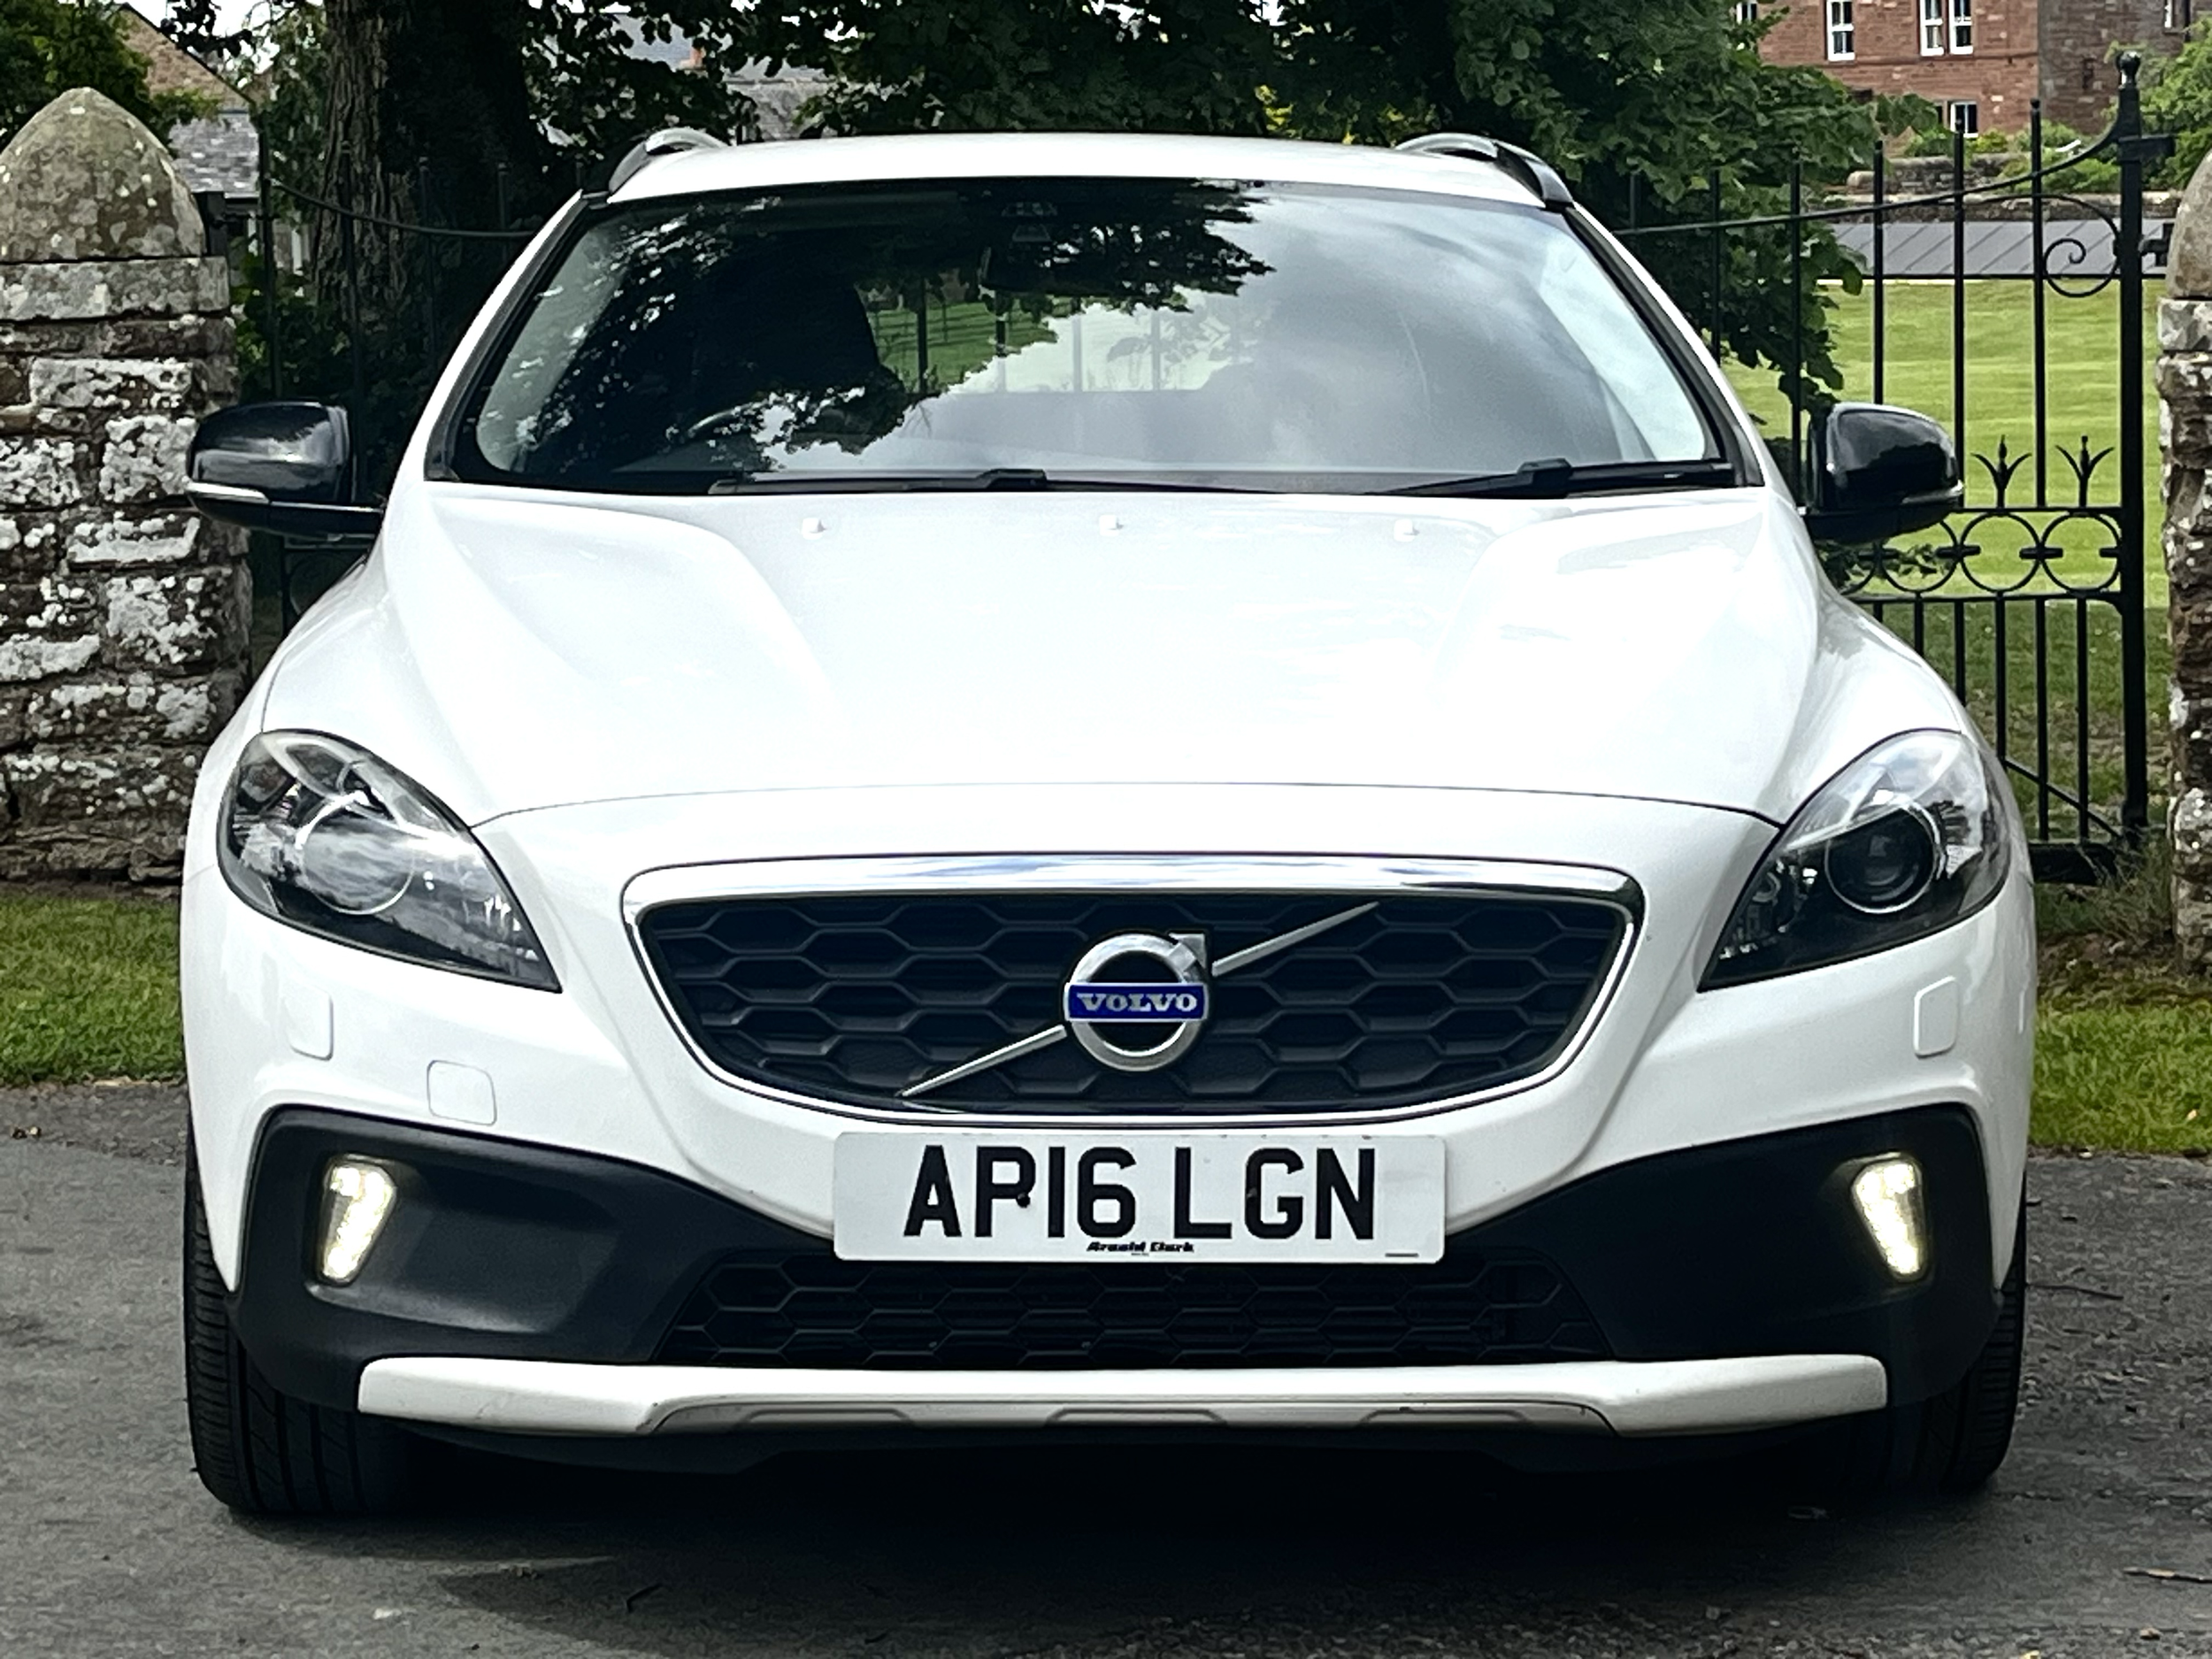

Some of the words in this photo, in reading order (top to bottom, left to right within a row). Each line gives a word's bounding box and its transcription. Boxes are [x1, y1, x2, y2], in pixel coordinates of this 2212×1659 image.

[1076, 993, 1197, 1012] VOLVO
[903, 1144, 1137, 1239] AP16
[1173, 1146, 1376, 1240] LGN
